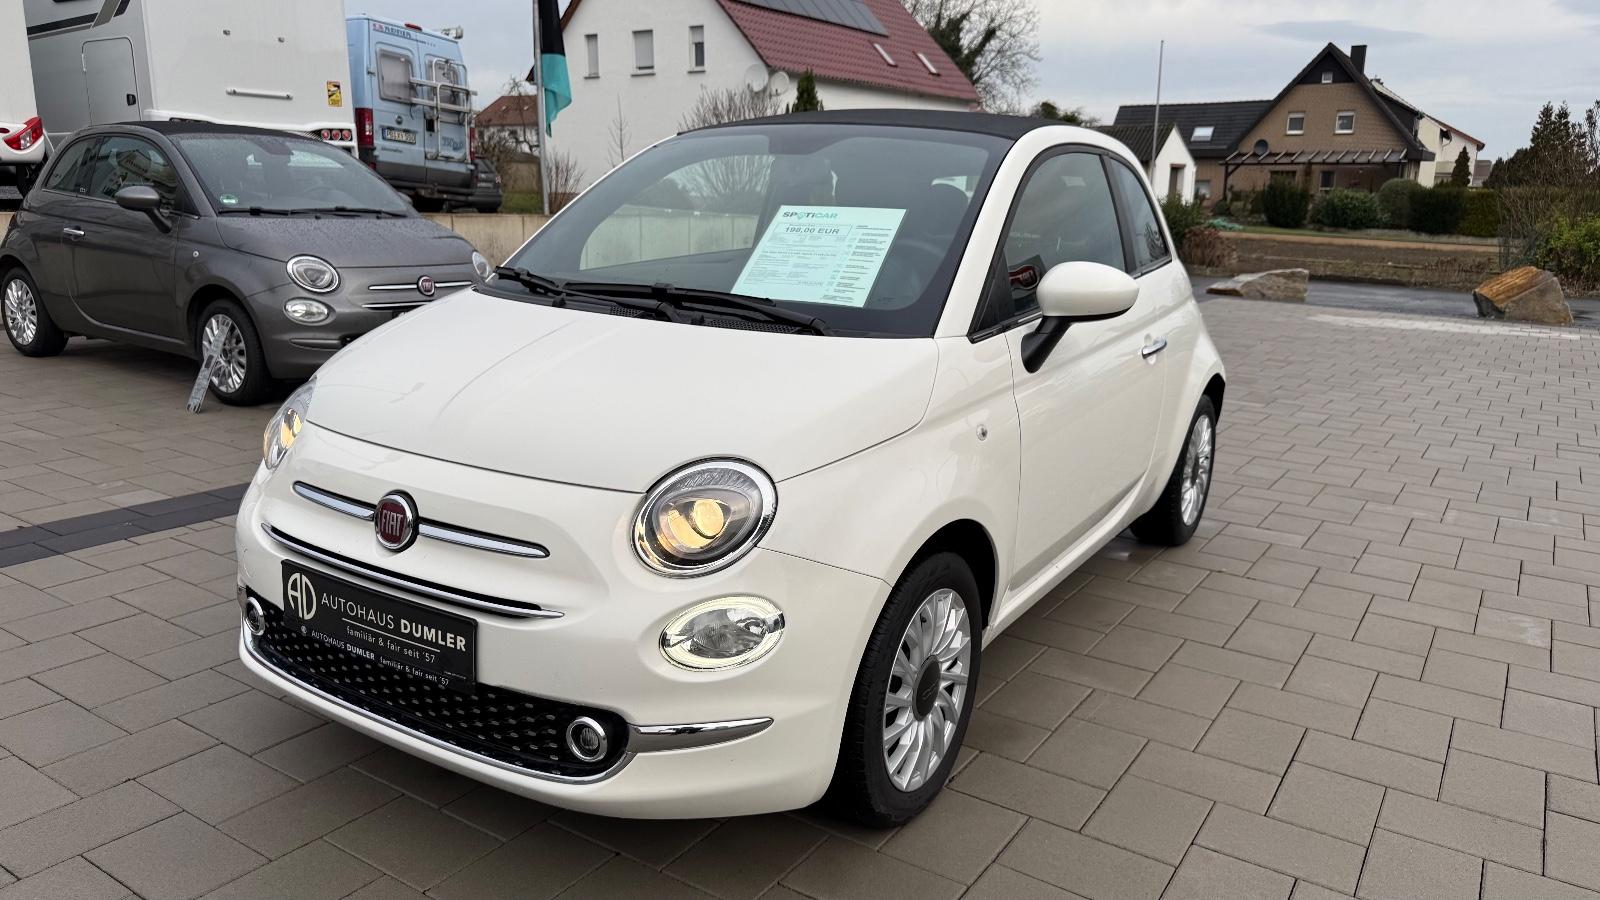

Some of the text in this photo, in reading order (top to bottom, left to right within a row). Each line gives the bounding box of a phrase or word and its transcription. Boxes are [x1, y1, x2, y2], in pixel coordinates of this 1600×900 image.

[381, 509, 404, 537] FIAT
[321, 593, 466, 652] AUTOHAUS DUMLER
[346, 625, 376, 644] familiär
[378, 637, 385, 647] &
[387, 640, 401, 652] fair
[403, 647, 420, 659] seit
[311, 630, 345, 649] AUTOHAUS
[346, 643, 375, 661] DUMLER
[380, 656, 404, 672] familiär
[405, 665, 411, 673] &
[412, 666, 424, 678] fair
[425, 672, 438, 683] seit
